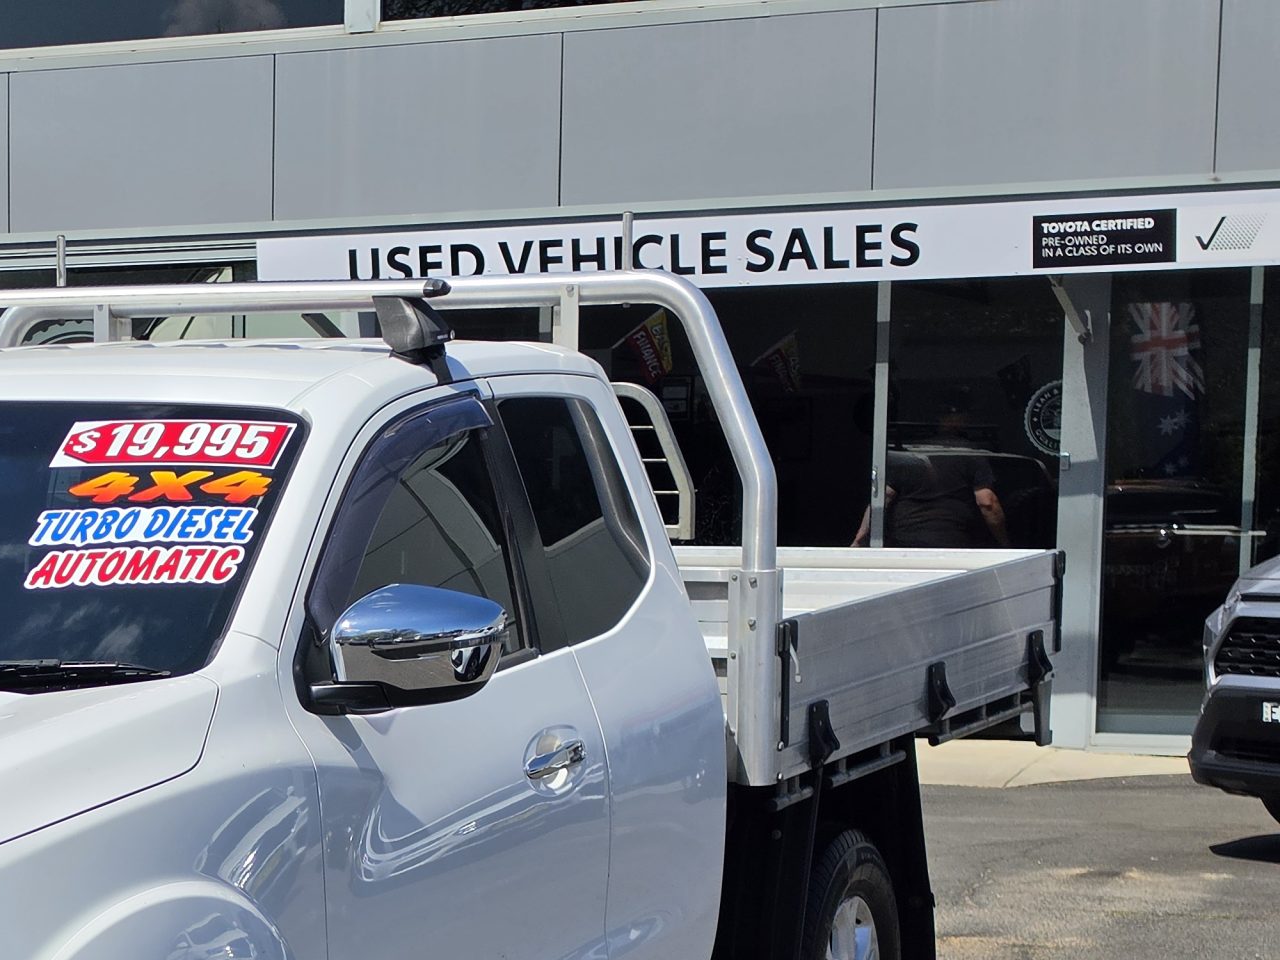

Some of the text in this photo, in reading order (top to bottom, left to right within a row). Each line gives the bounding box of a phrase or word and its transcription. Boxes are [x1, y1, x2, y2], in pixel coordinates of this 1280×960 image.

[1041, 217, 1156, 234] TOYOTA CERTIFIED
[1041, 234, 1108, 247] PRE-OWNED
[348, 221, 921, 280] USED VEHICLE SALES
[1041, 242, 1163, 258] IN A CLASS OF ITS OWN
[68, 470, 273, 504] 4X4
[34, 507, 255, 543] TURBO DIESEL
[28, 548, 242, 586] AUTOMATIC
